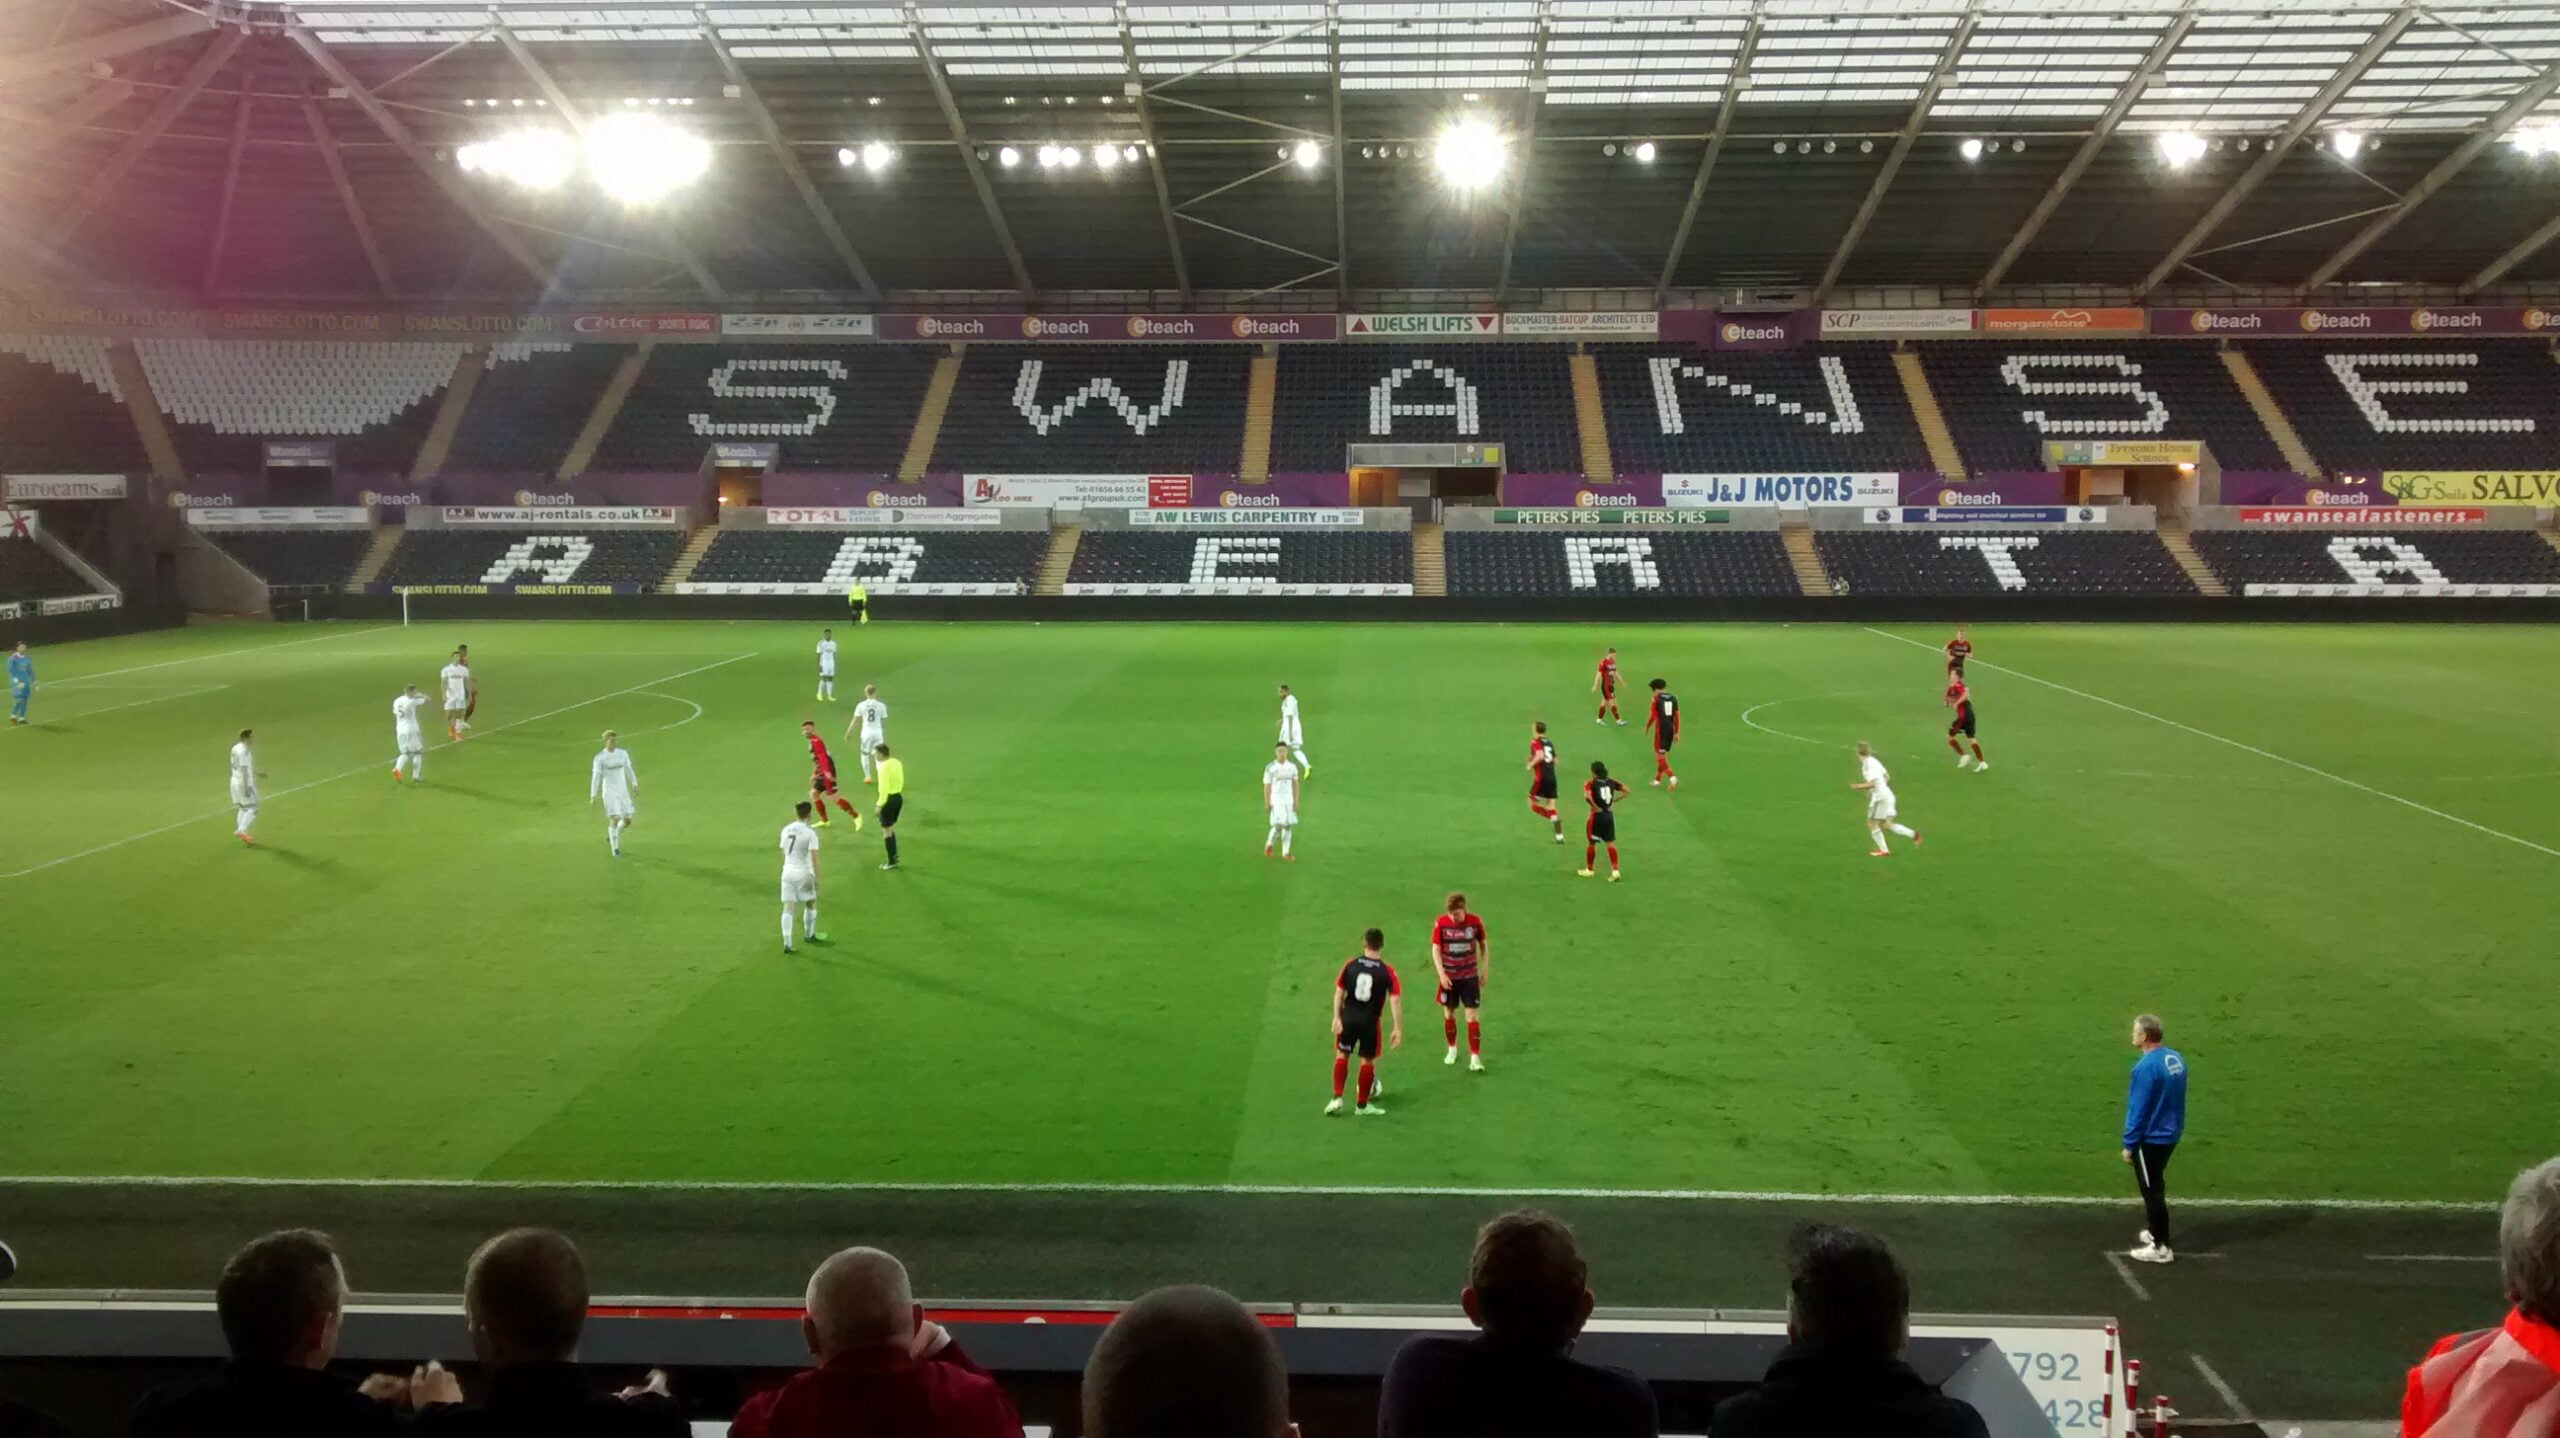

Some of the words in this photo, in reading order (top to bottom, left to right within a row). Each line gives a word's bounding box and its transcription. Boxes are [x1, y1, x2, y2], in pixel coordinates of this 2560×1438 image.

[222, 311, 381, 331] SWANSLOTTO.COM
[402, 315, 552, 333] SWANSLOTTO.COM
[923, 317, 984, 334] eteach
[1028, 317, 1089, 334] eteach
[1133, 317, 1194, 334] eteach
[1238, 317, 1300, 334] eteach
[1371, 316, 1429, 332] WELSH
[1432, 316, 1474, 332] LIFTS
[1591, 314, 1638, 324] ARCHITECTS
[1640, 314, 1656, 323] LTD
[1826, 313, 1861, 328] SCP
[1989, 318, 2087, 330] morganstone
[2199, 311, 2262, 328] eteach
[2306, 311, 2371, 328] eteach
[2419, 310, 2482, 327] eteach
[1727, 322, 1784, 341] eteach
[1667, 488, 1703, 496] SUZUKI
[1706, 477, 1747, 502] J&J
[1754, 476, 1853, 502] MOTORS
[1857, 487, 1894, 495] SUZUKI
[1945, 489, 2001, 506] eteach
[2311, 489, 2369, 506] eteach
[174, 492, 233, 506] eteach
[365, 492, 421, 506] eteach
[520, 491, 575, 506] eteach
[872, 491, 927, 507] eteach
[1226, 490, 1280, 507] eteach
[1581, 490, 1637, 507] eteach
[477, 507, 639, 522] www.aj-rentals.co.uk
[945, 511, 998, 523] Aggregates
[1154, 511, 1178, 523] AW
[1182, 511, 1227, 523] LEWIS
[1231, 511, 1317, 524] CARPENTRY
[1321, 514, 1339, 523] LTD
[1517, 510, 1569, 524] PETERS
[1571, 510, 1600, 524] PIES
[1622, 510, 1674, 524] PETERS
[1677, 510, 1706, 524] PIES
[866, 708, 876, 724] 8
[1544, 745, 1553, 764] 5
[1600, 786, 1612, 805] 4
[787, 834, 797, 855] 7
[1354, 972, 1374, 1002] 8
[2003, 1352, 2081, 1382] 792
